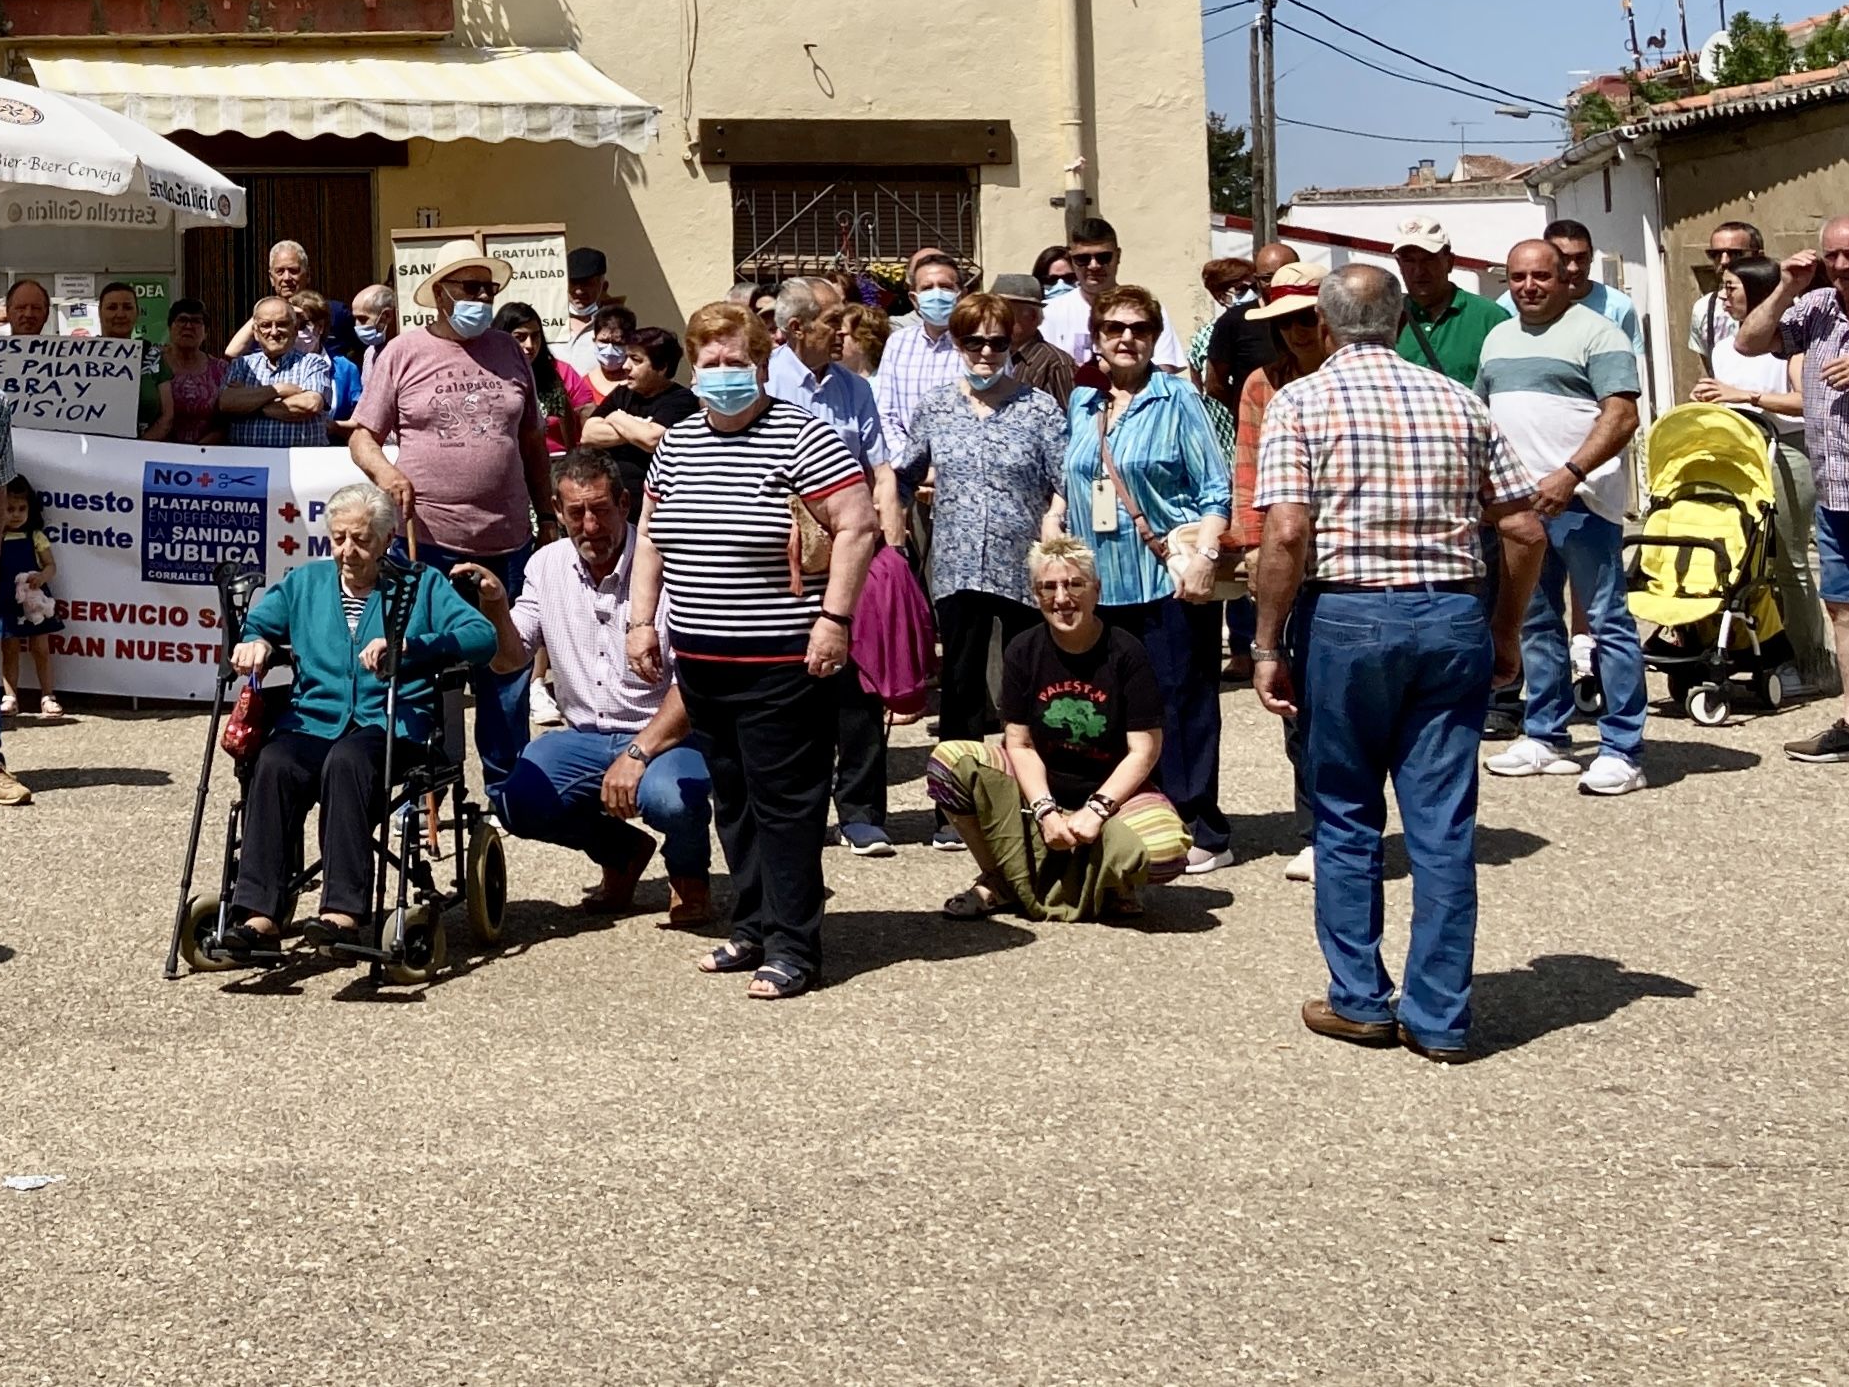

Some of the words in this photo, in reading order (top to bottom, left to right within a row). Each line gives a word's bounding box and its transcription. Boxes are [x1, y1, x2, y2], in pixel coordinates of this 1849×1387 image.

[398, 263, 436, 276] SAN
[129, 282, 164, 298] DEA
[402, 311, 436, 327] PÚB
[542, 317, 566, 327] SAL
[21, 359, 134, 381] PALABRA
[154, 468, 193, 487] NO
[37, 490, 134, 513] puesto
[148, 496, 260, 514] PLATAFORMA
[148, 510, 168, 523] EN
[173, 511, 238, 526] DEFENSA
[242, 515, 260, 528] DE
[43, 522, 133, 549] ciente
[148, 527, 166, 539] LA
[171, 525, 260, 544] SANIDAD
[148, 540, 260, 564] PÚBLICA
[147, 569, 206, 581] CORRALES
[55, 598, 189, 627] SERVICIO
